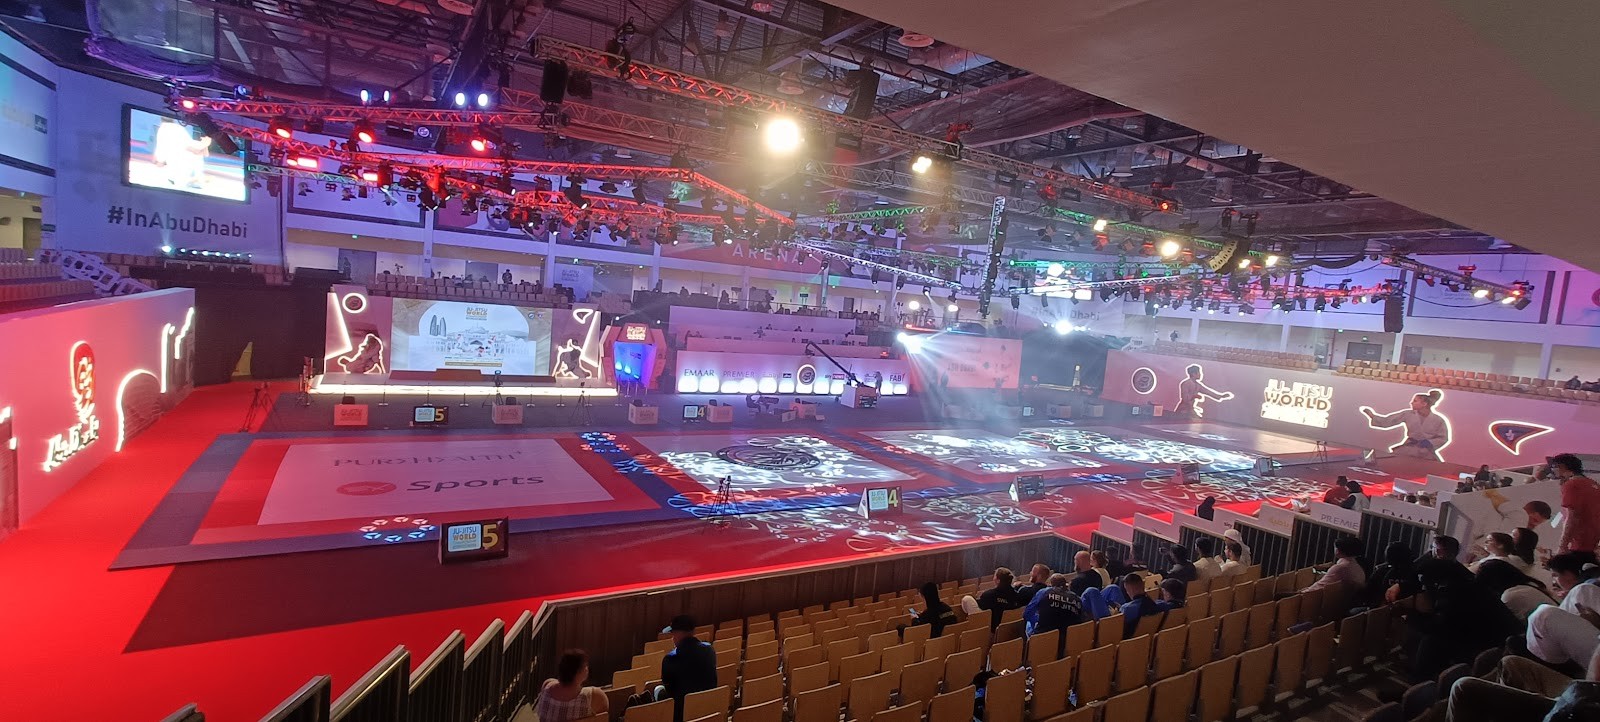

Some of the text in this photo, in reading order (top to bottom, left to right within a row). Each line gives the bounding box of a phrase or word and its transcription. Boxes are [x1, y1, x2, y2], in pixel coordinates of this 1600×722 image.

[107, 205, 248, 240] #InAbuDhabi
[684, 368, 716, 377] EMAAR
[889, 375, 903, 383] FAB
[1264, 391, 1329, 411] WORLD
[434, 408, 445, 422] 5
[406, 476, 545, 493] Sports
[888, 489, 899, 508] 4
[452, 526, 477, 535] JU-JITSU
[452, 533, 477, 541] WORLD
[482, 523, 499, 549] 5
[1048, 593, 1082, 610] HELLAS
